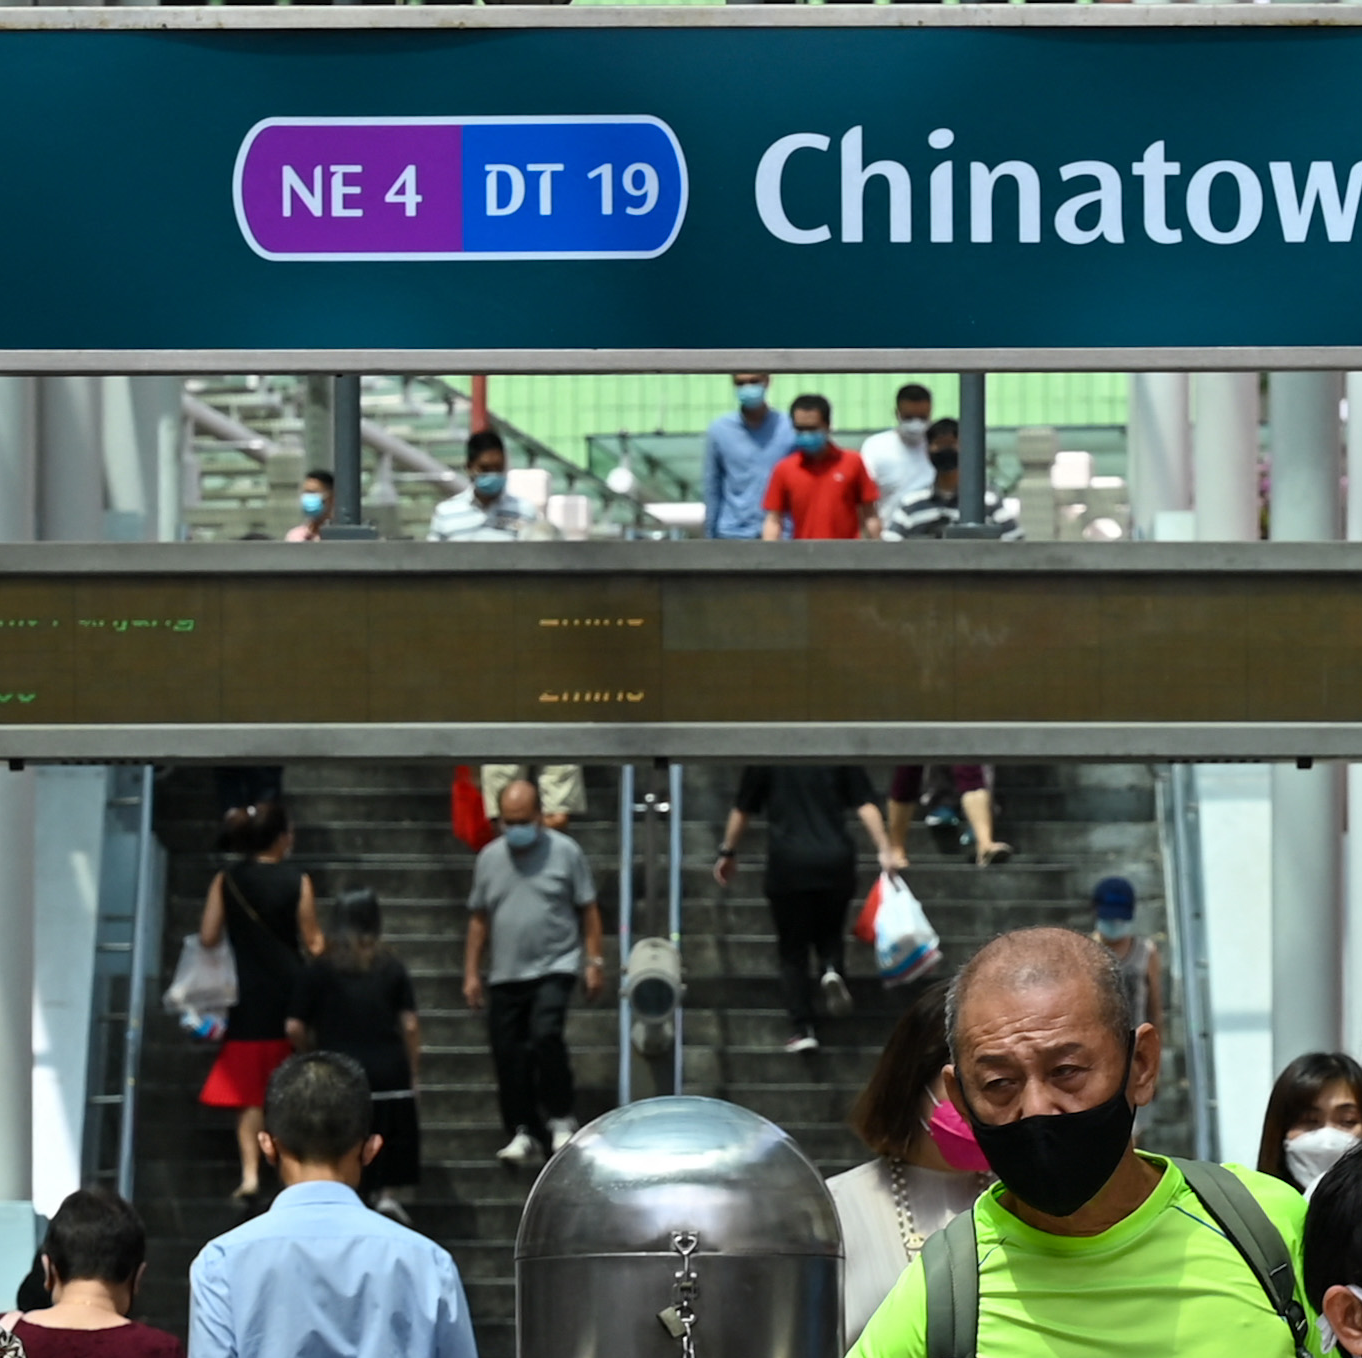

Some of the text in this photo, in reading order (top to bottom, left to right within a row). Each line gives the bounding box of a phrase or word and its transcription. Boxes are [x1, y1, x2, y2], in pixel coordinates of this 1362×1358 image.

[282, 164, 364, 217] NE
[384, 164, 423, 217] 4
[484, 163, 565, 217] DT
[587, 162, 659, 216] 19
